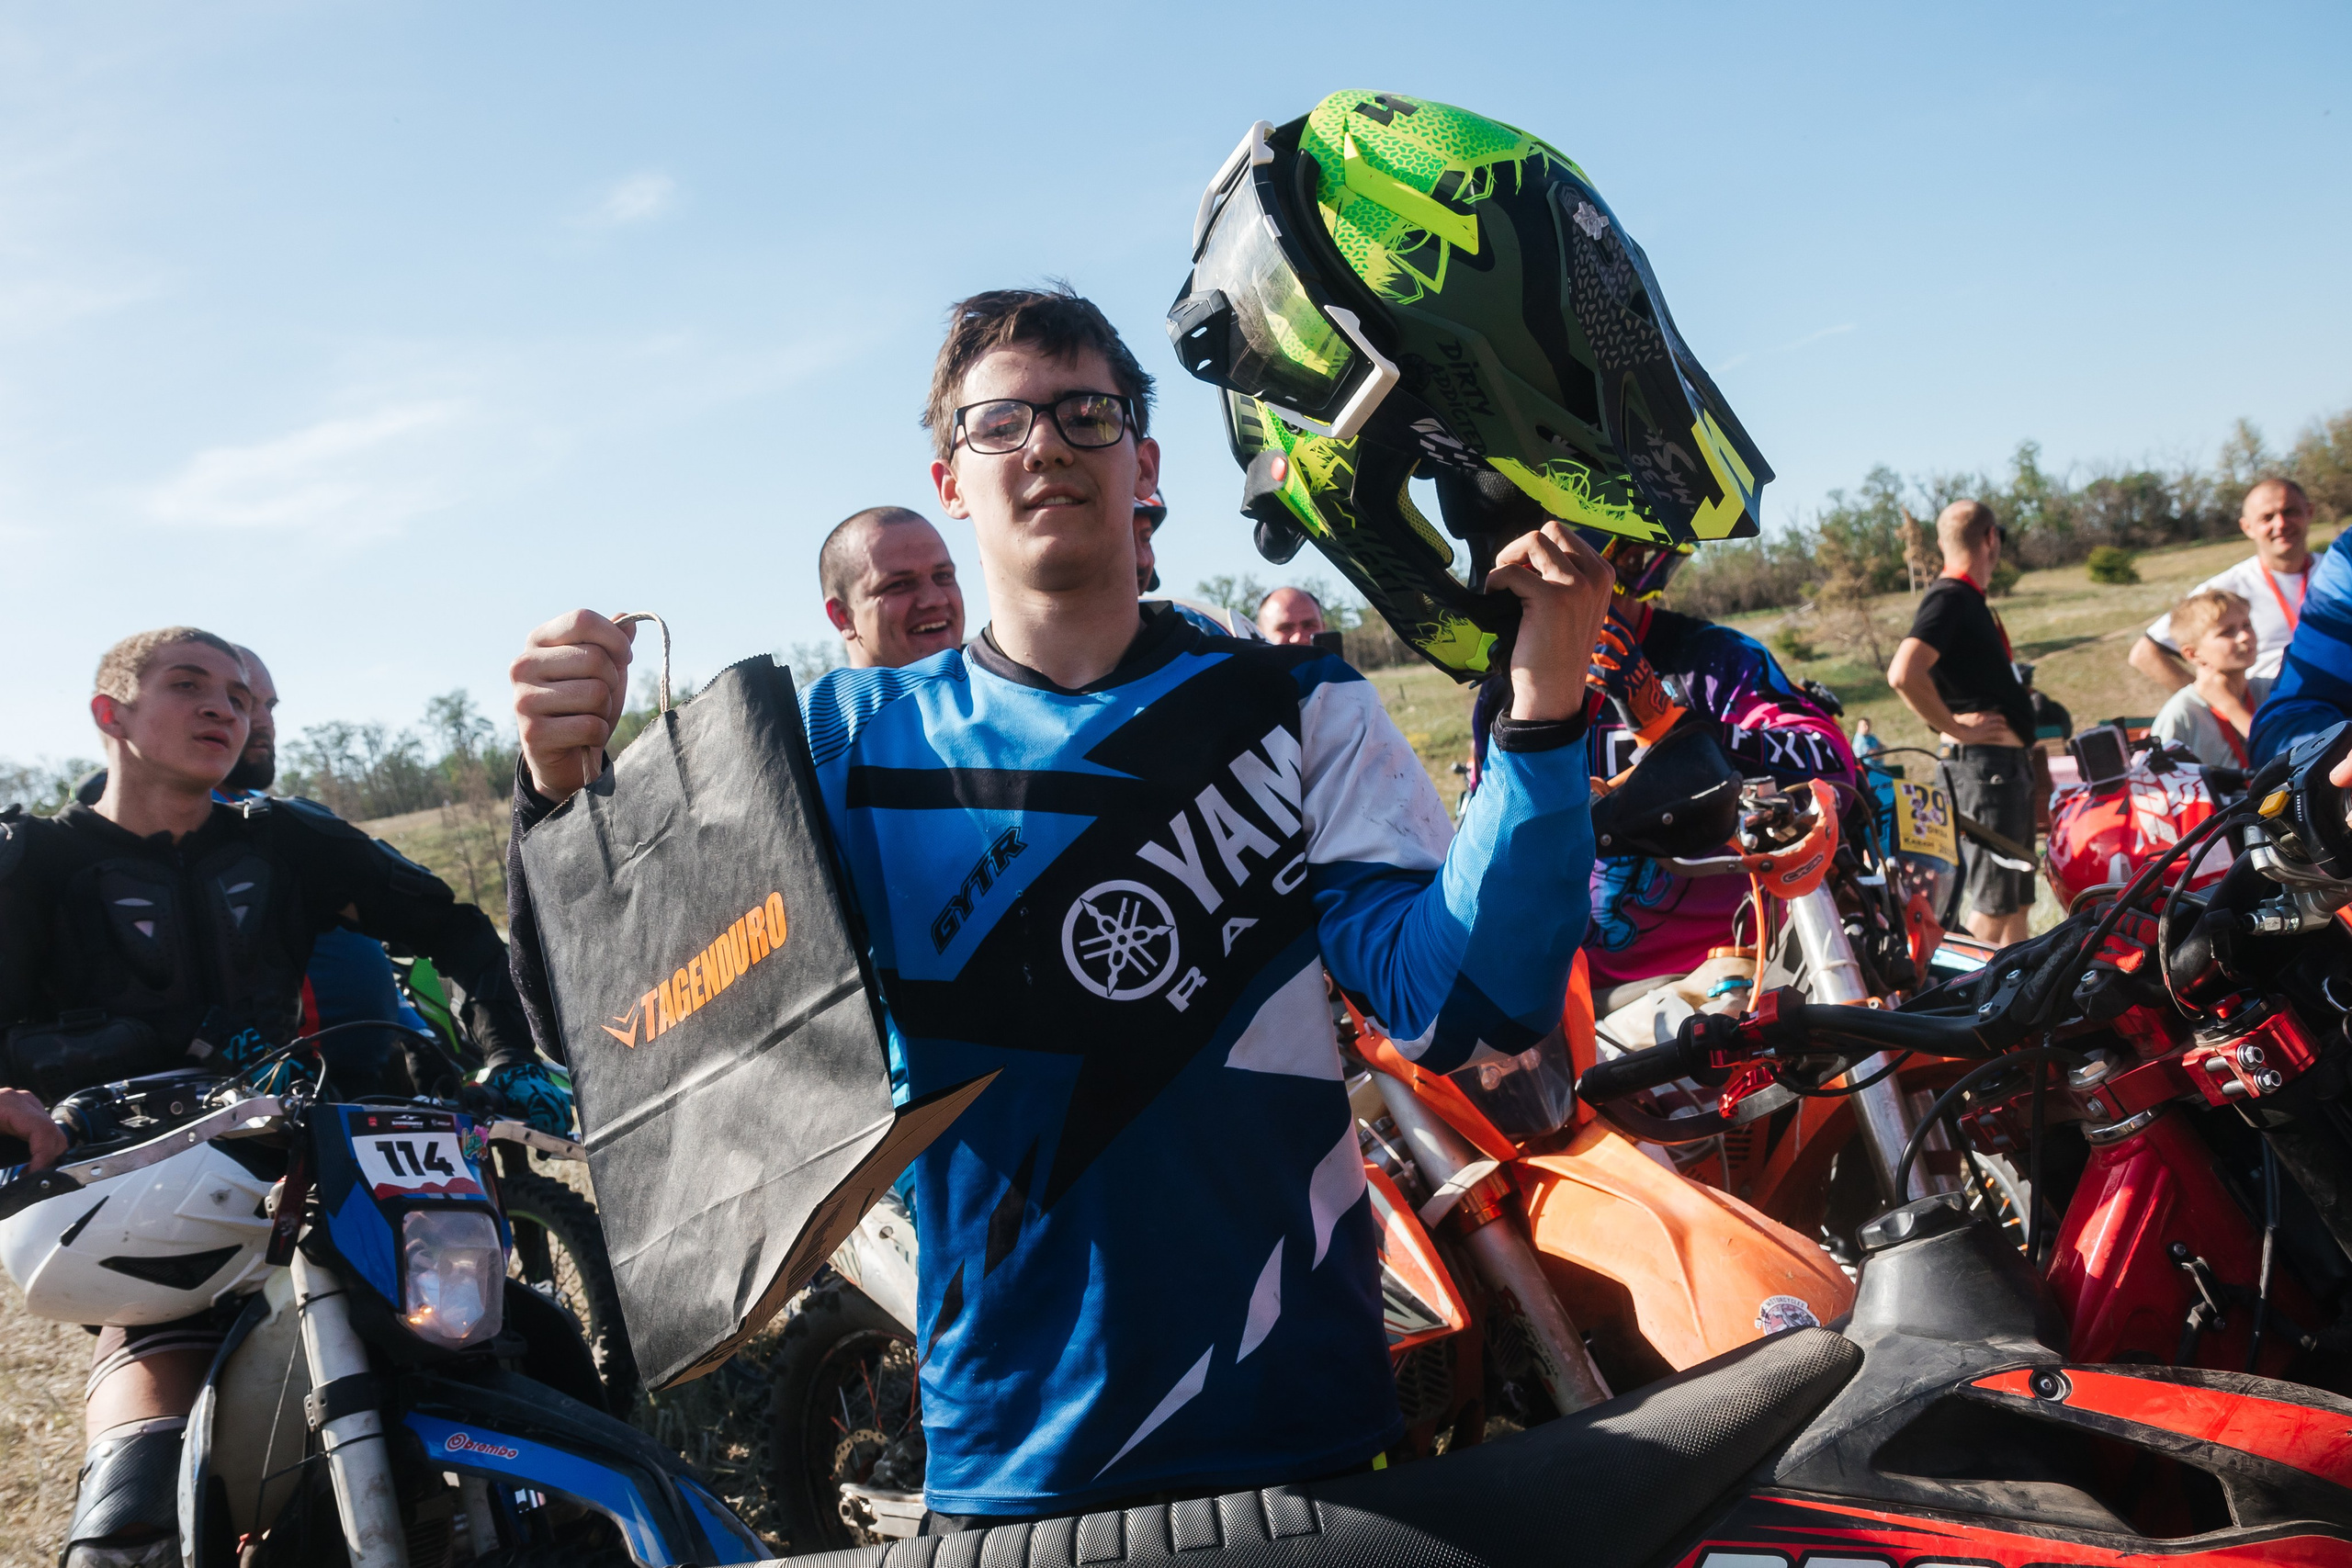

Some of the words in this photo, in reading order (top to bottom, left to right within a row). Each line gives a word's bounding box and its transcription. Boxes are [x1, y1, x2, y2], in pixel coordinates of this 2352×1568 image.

[931, 827, 1029, 955] GYTR
[641, 891, 788, 1043] TAGENDURO
[375, 1141, 456, 1177] 114
[1765, 1296, 1805, 1309] MOTORCYCLES
